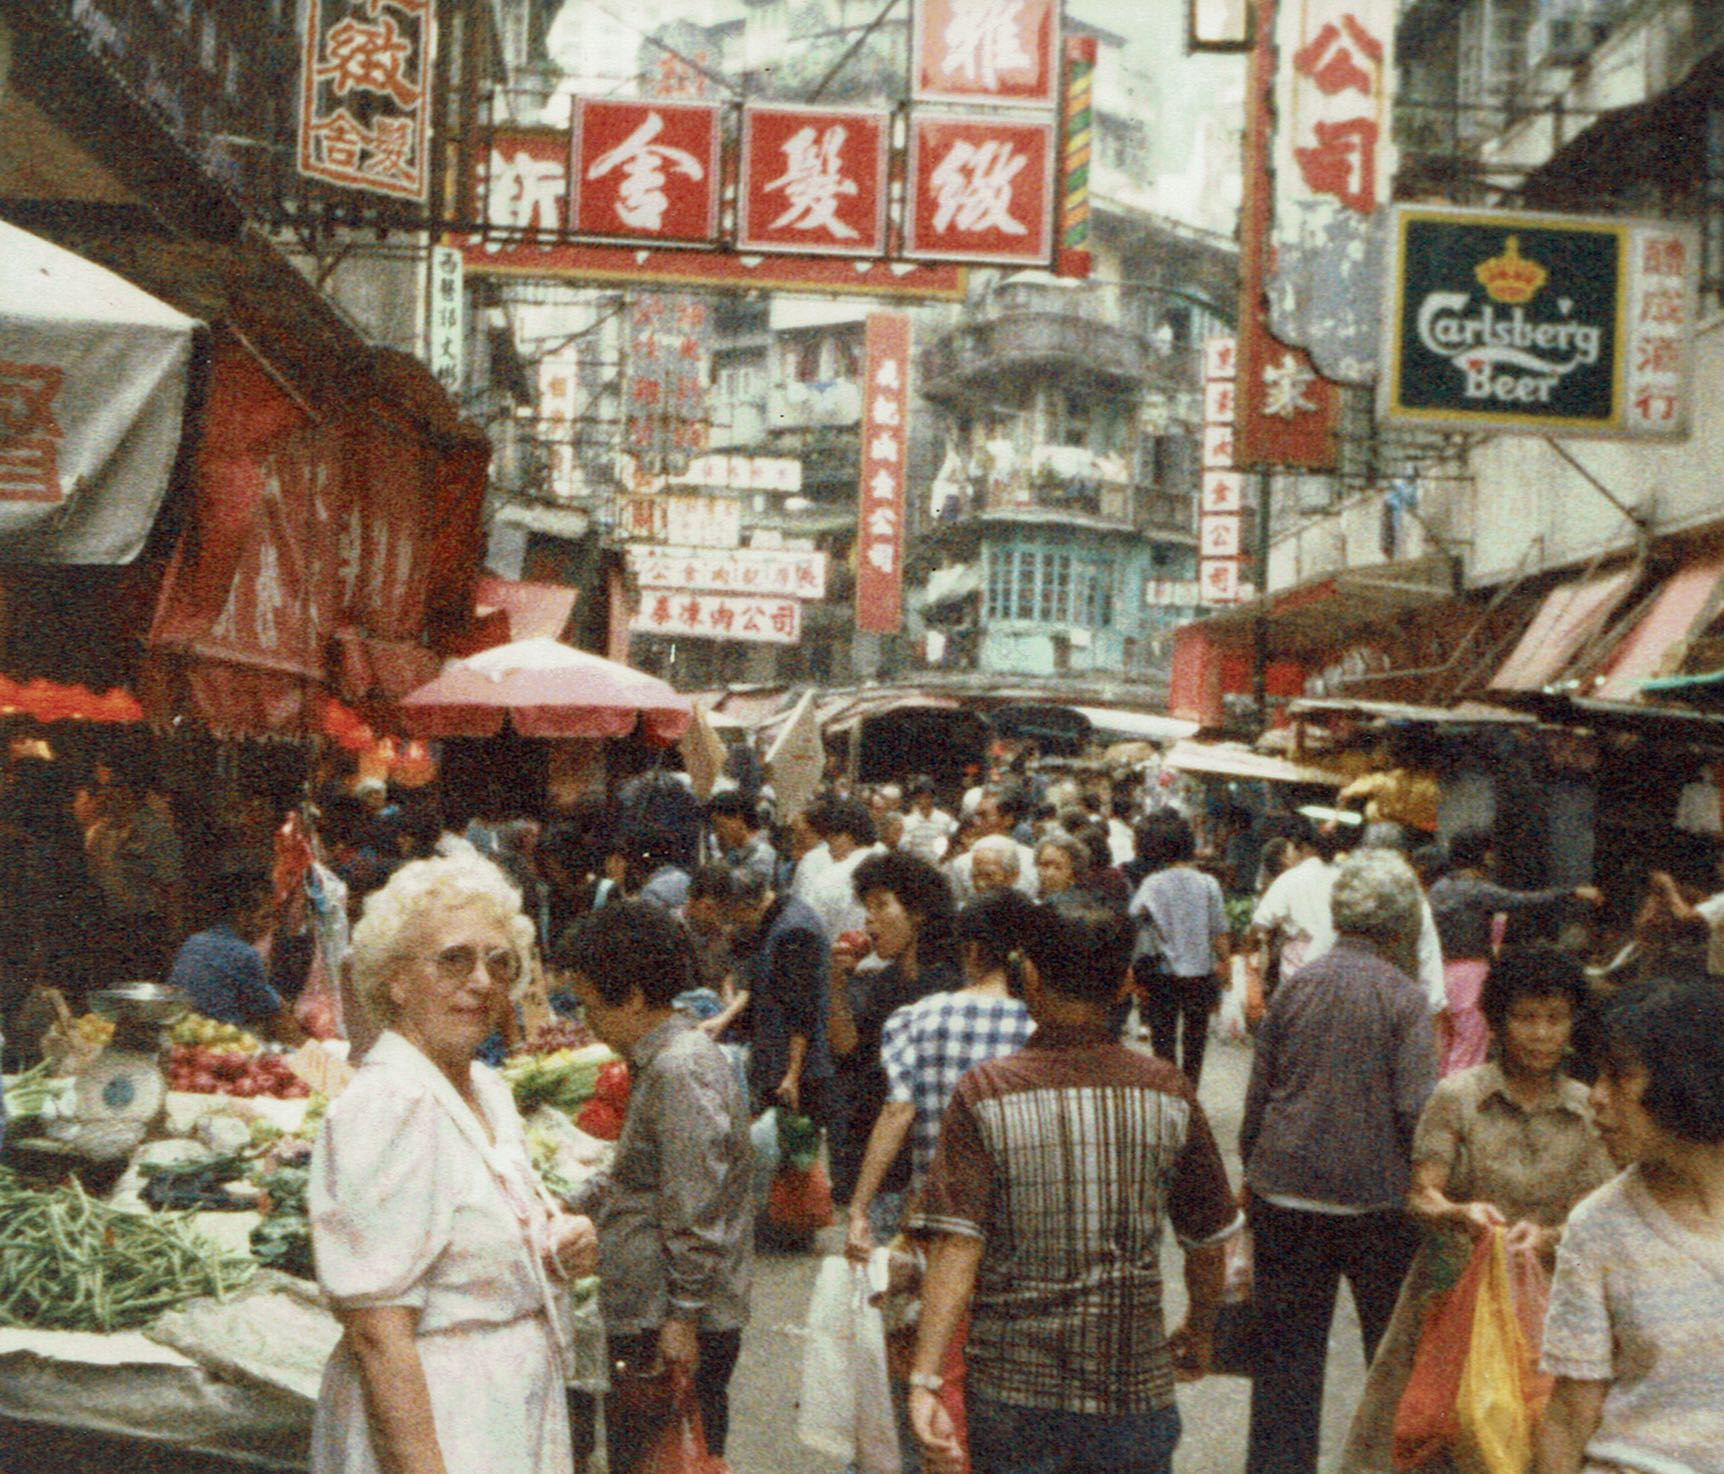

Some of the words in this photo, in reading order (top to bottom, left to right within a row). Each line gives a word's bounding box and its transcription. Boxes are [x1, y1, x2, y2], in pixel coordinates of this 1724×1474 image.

[1292, 12, 1384, 215] 公司
[1417, 292, 1601, 364] Carlsberg
[1464, 358, 1559, 402] Beer
